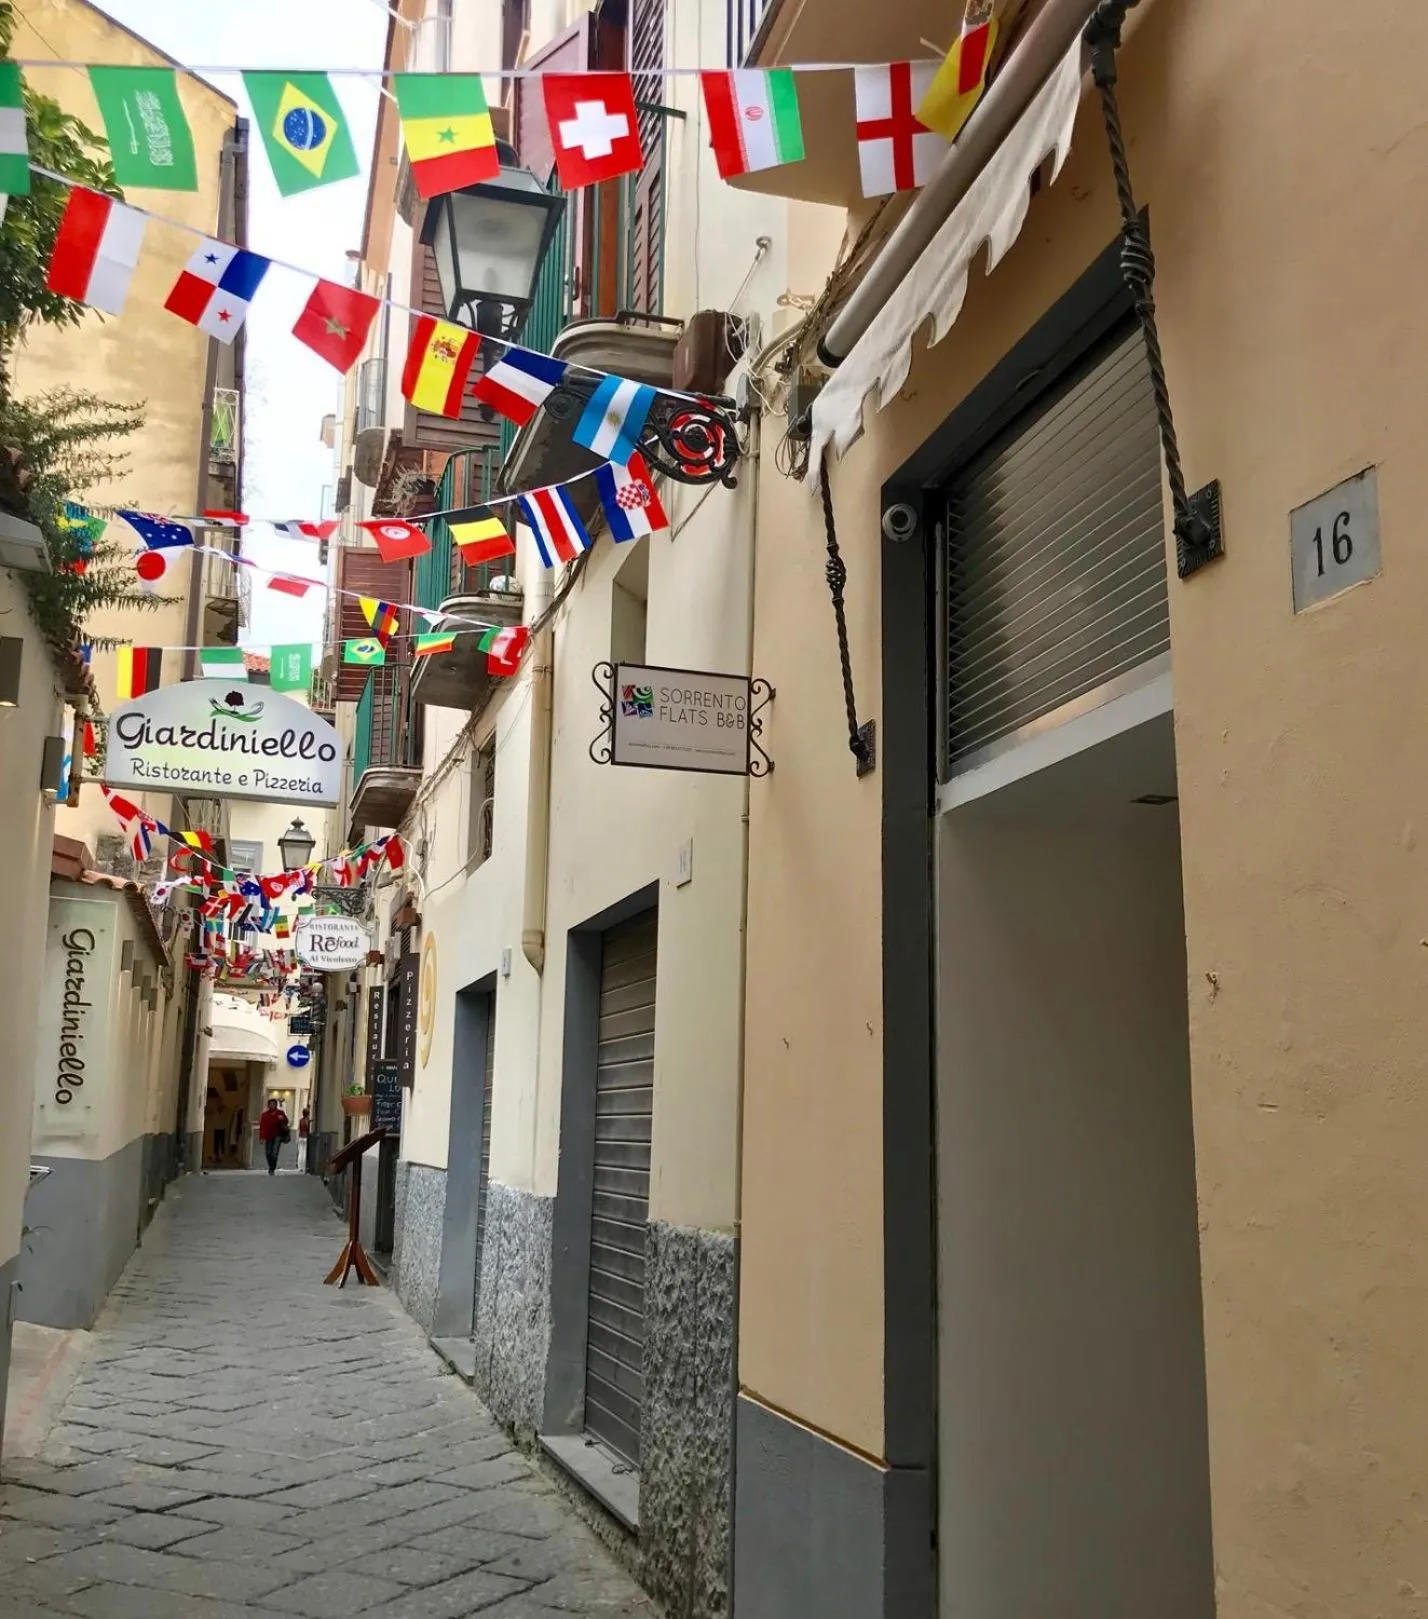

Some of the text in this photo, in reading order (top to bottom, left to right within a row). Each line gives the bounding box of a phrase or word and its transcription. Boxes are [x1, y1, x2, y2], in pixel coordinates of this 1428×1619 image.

[1312, 511, 1353, 577] 16
[659, 686, 747, 711] SORRENTO
[659, 705, 745, 729] FLATS B&B
[115, 712, 337, 762] Giardiniello
[129, 757, 324, 794] Ristorante e Pizzeria
[55, 928, 96, 1105] Giardiniello
[402, 970, 414, 1070] Pizzeria
